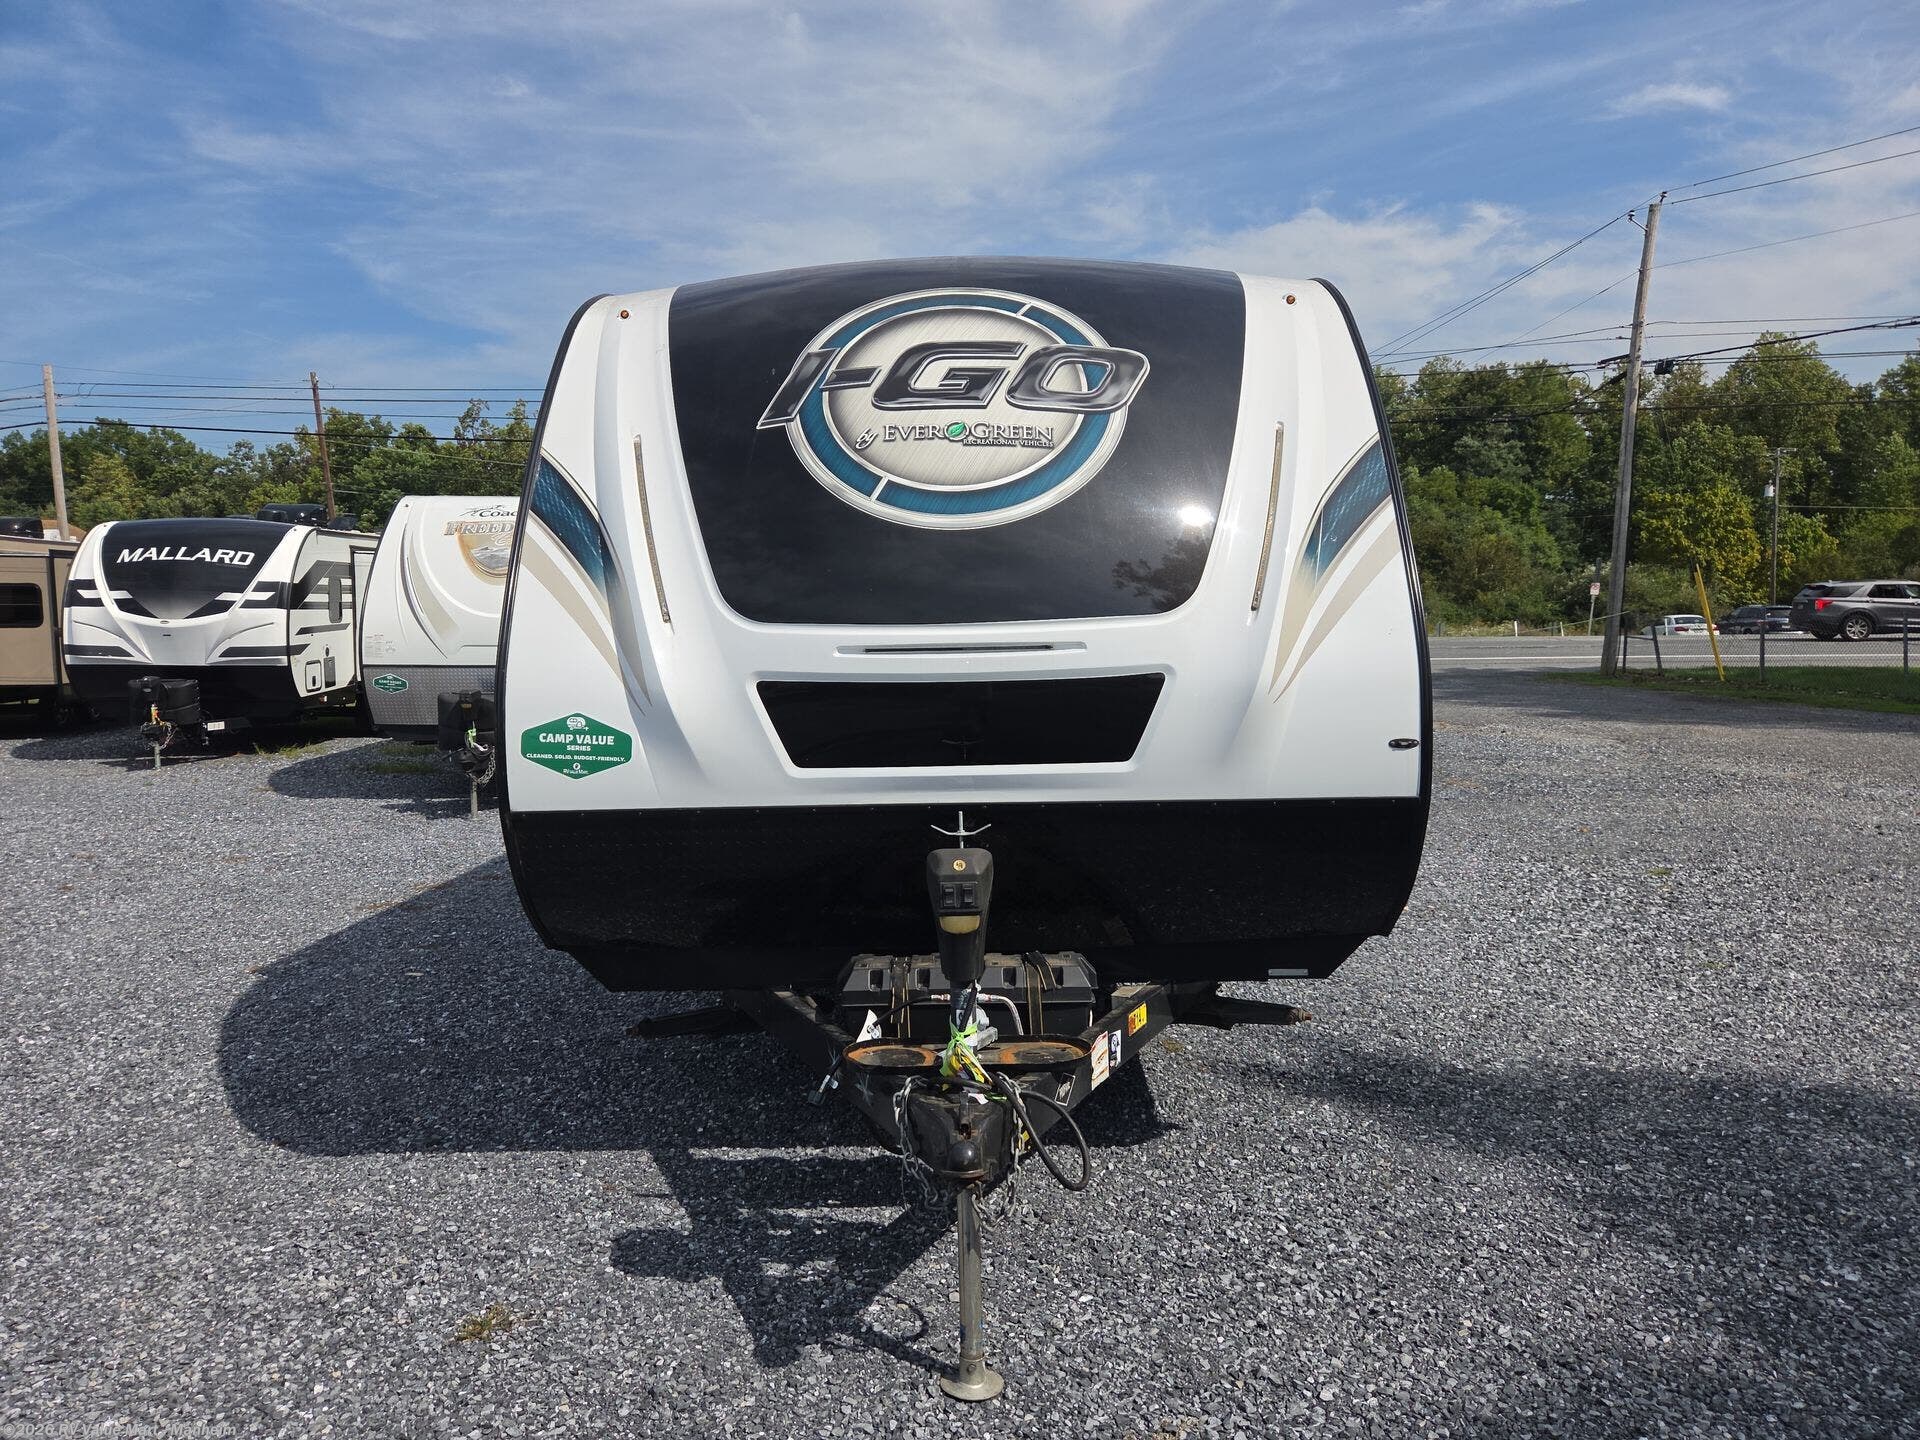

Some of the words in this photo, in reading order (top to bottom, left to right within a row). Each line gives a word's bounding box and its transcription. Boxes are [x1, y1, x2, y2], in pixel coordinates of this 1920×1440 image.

[756, 341, 1150, 429] I-GO
[855, 427, 878, 450] by
[963, 438, 1017, 446] RECREATIONAL
[1019, 439, 1055, 448] VEHICLES
[116, 546, 256, 566] MALLARD
[539, 733, 573, 744] CAMP
[576, 734, 615, 745] VALUE
